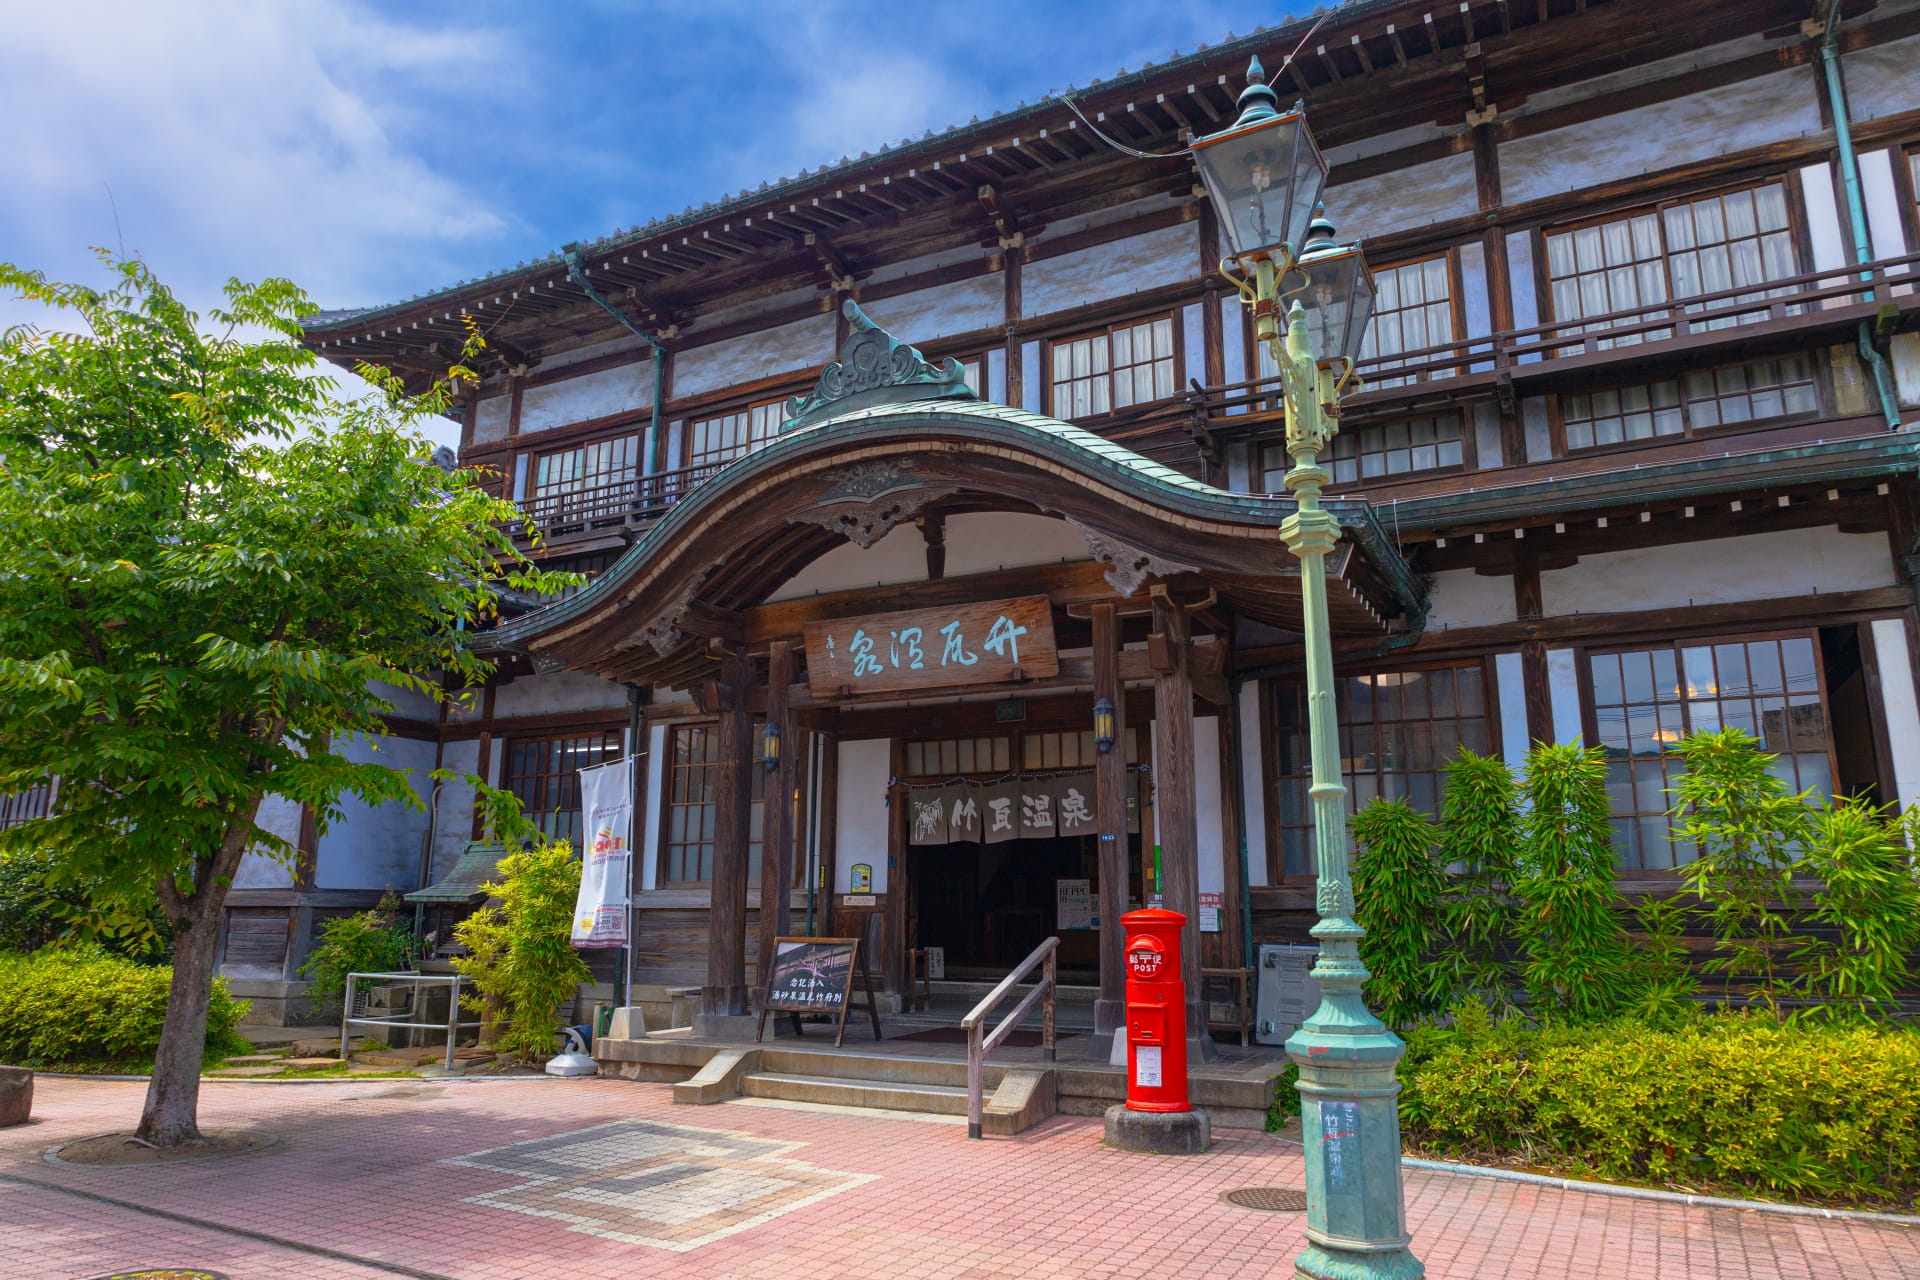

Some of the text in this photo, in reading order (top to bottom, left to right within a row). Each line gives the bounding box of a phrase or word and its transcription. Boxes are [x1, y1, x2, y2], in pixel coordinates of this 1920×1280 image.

[951, 787, 1095, 832] 竹瓦温泉
[1059, 887, 1088, 896] BEPPU
[1134, 964, 1157, 972] POST
